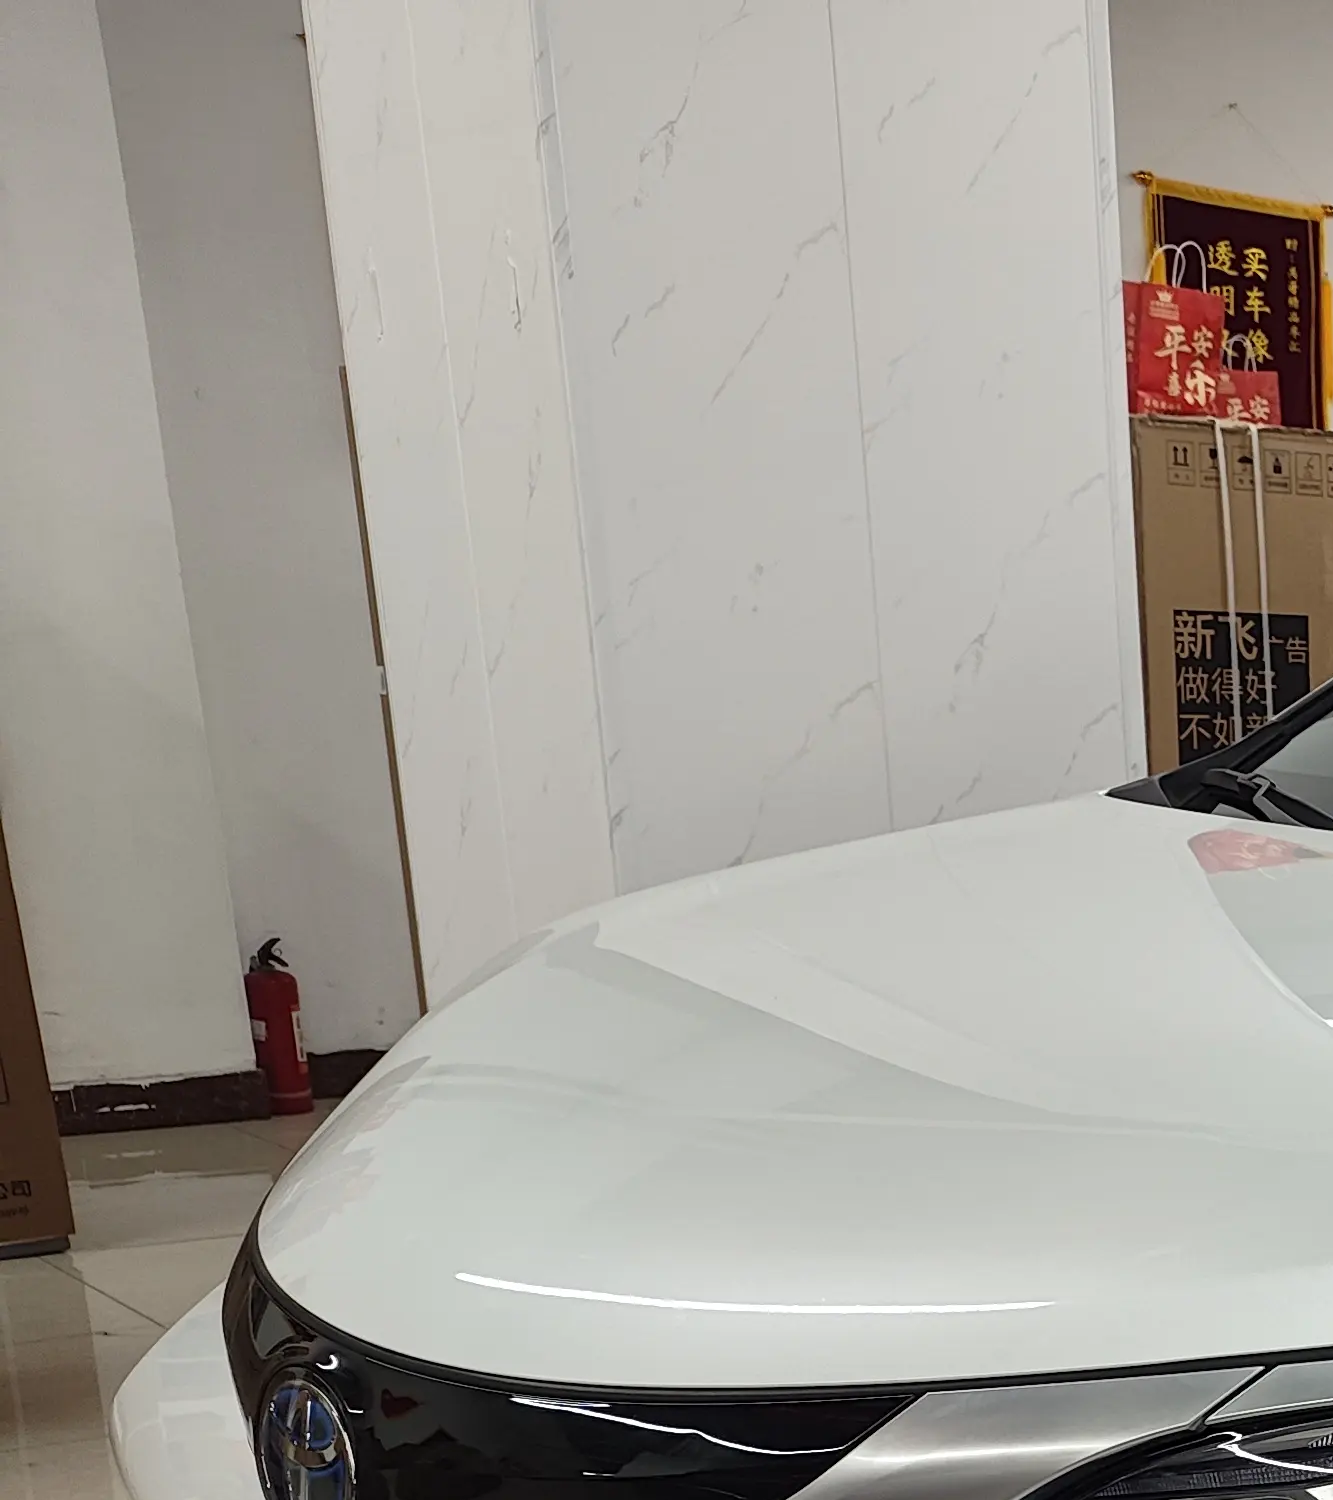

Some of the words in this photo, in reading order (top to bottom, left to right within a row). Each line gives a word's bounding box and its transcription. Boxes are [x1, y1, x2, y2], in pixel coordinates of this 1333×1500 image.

[1154, 324, 1215, 370] 平安
[1176, 667, 1277, 705] 做得好
